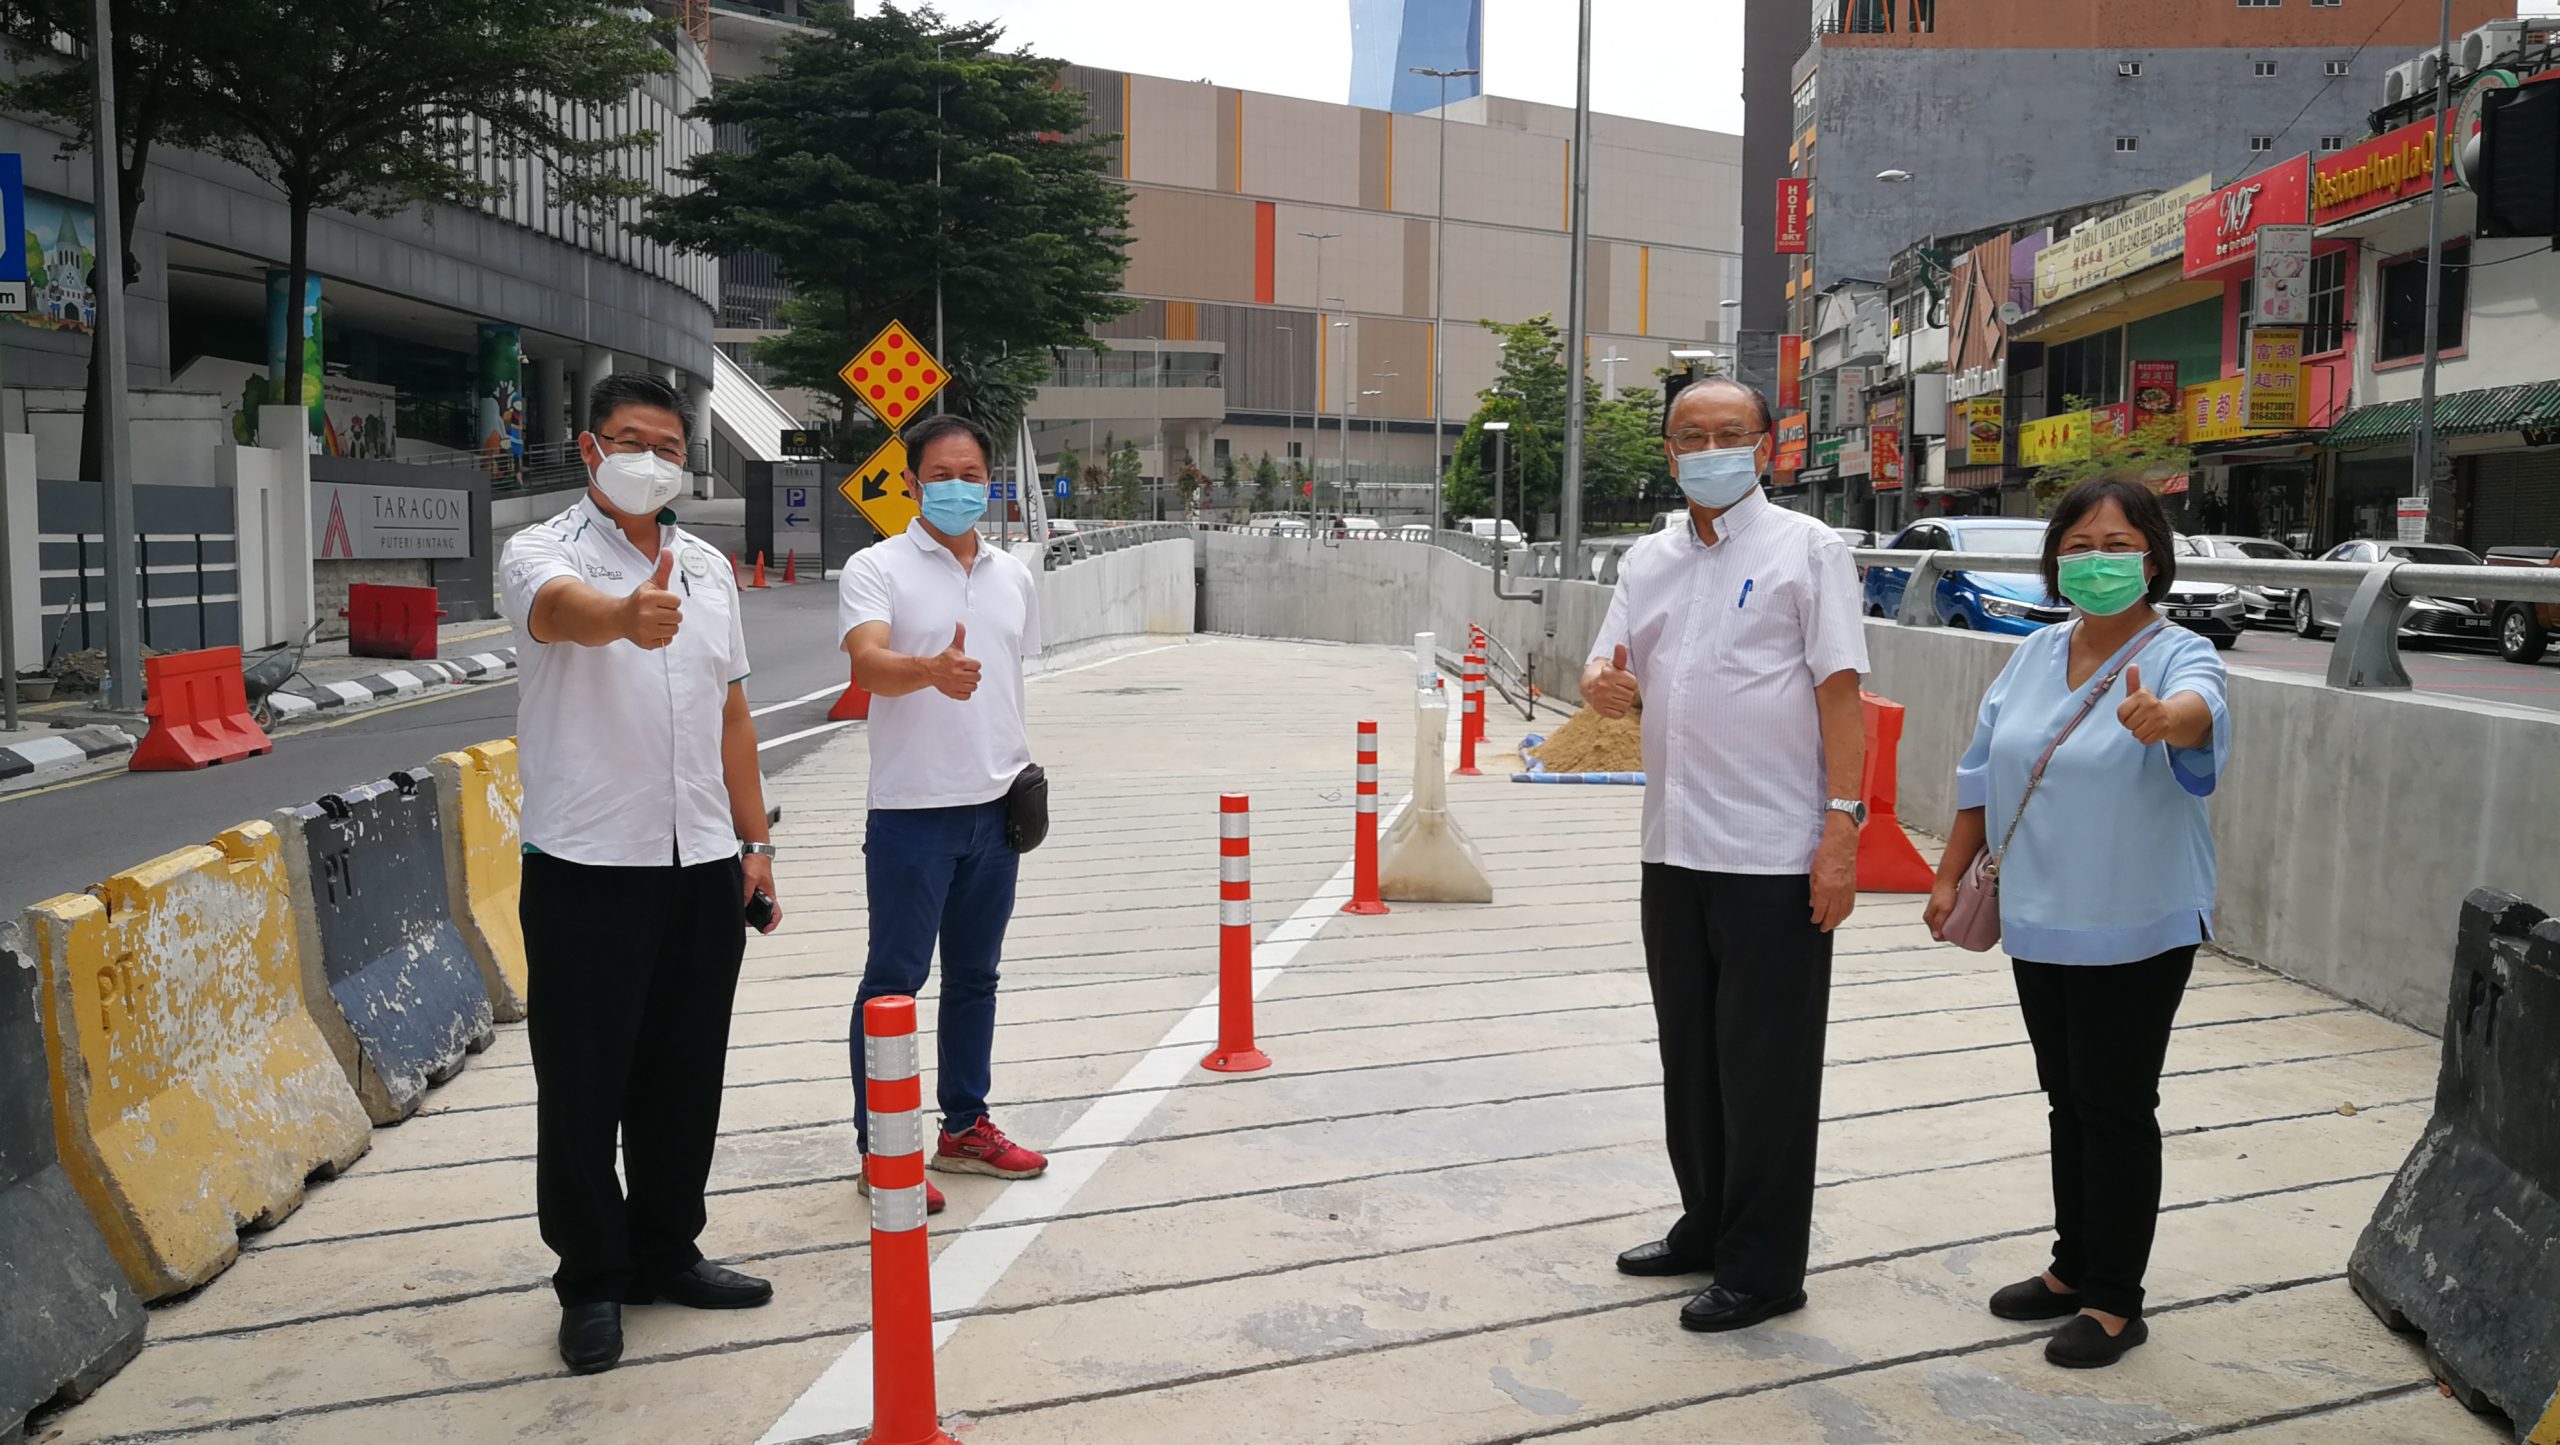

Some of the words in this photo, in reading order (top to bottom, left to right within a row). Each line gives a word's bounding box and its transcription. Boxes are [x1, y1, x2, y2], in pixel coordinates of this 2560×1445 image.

[1787, 185, 1798, 234] HOTEL
[1781, 233, 1801, 241] SKY
[2073, 231, 2099, 253] GLOBAL
[2134, 199, 2166, 228] HOLIDAY
[2255, 343, 2296, 361] 富都
[2253, 372, 2295, 388] 超市
[787, 446, 814, 454] TEKSI
[373, 495, 460, 520] TARAGON
[381, 536, 413, 550] PUTERI
[417, 537, 455, 550] BINTANG
[324, 848, 352, 905] PT
[97, 952, 134, 1034] PT
[2465, 969, 2504, 1048] PT
